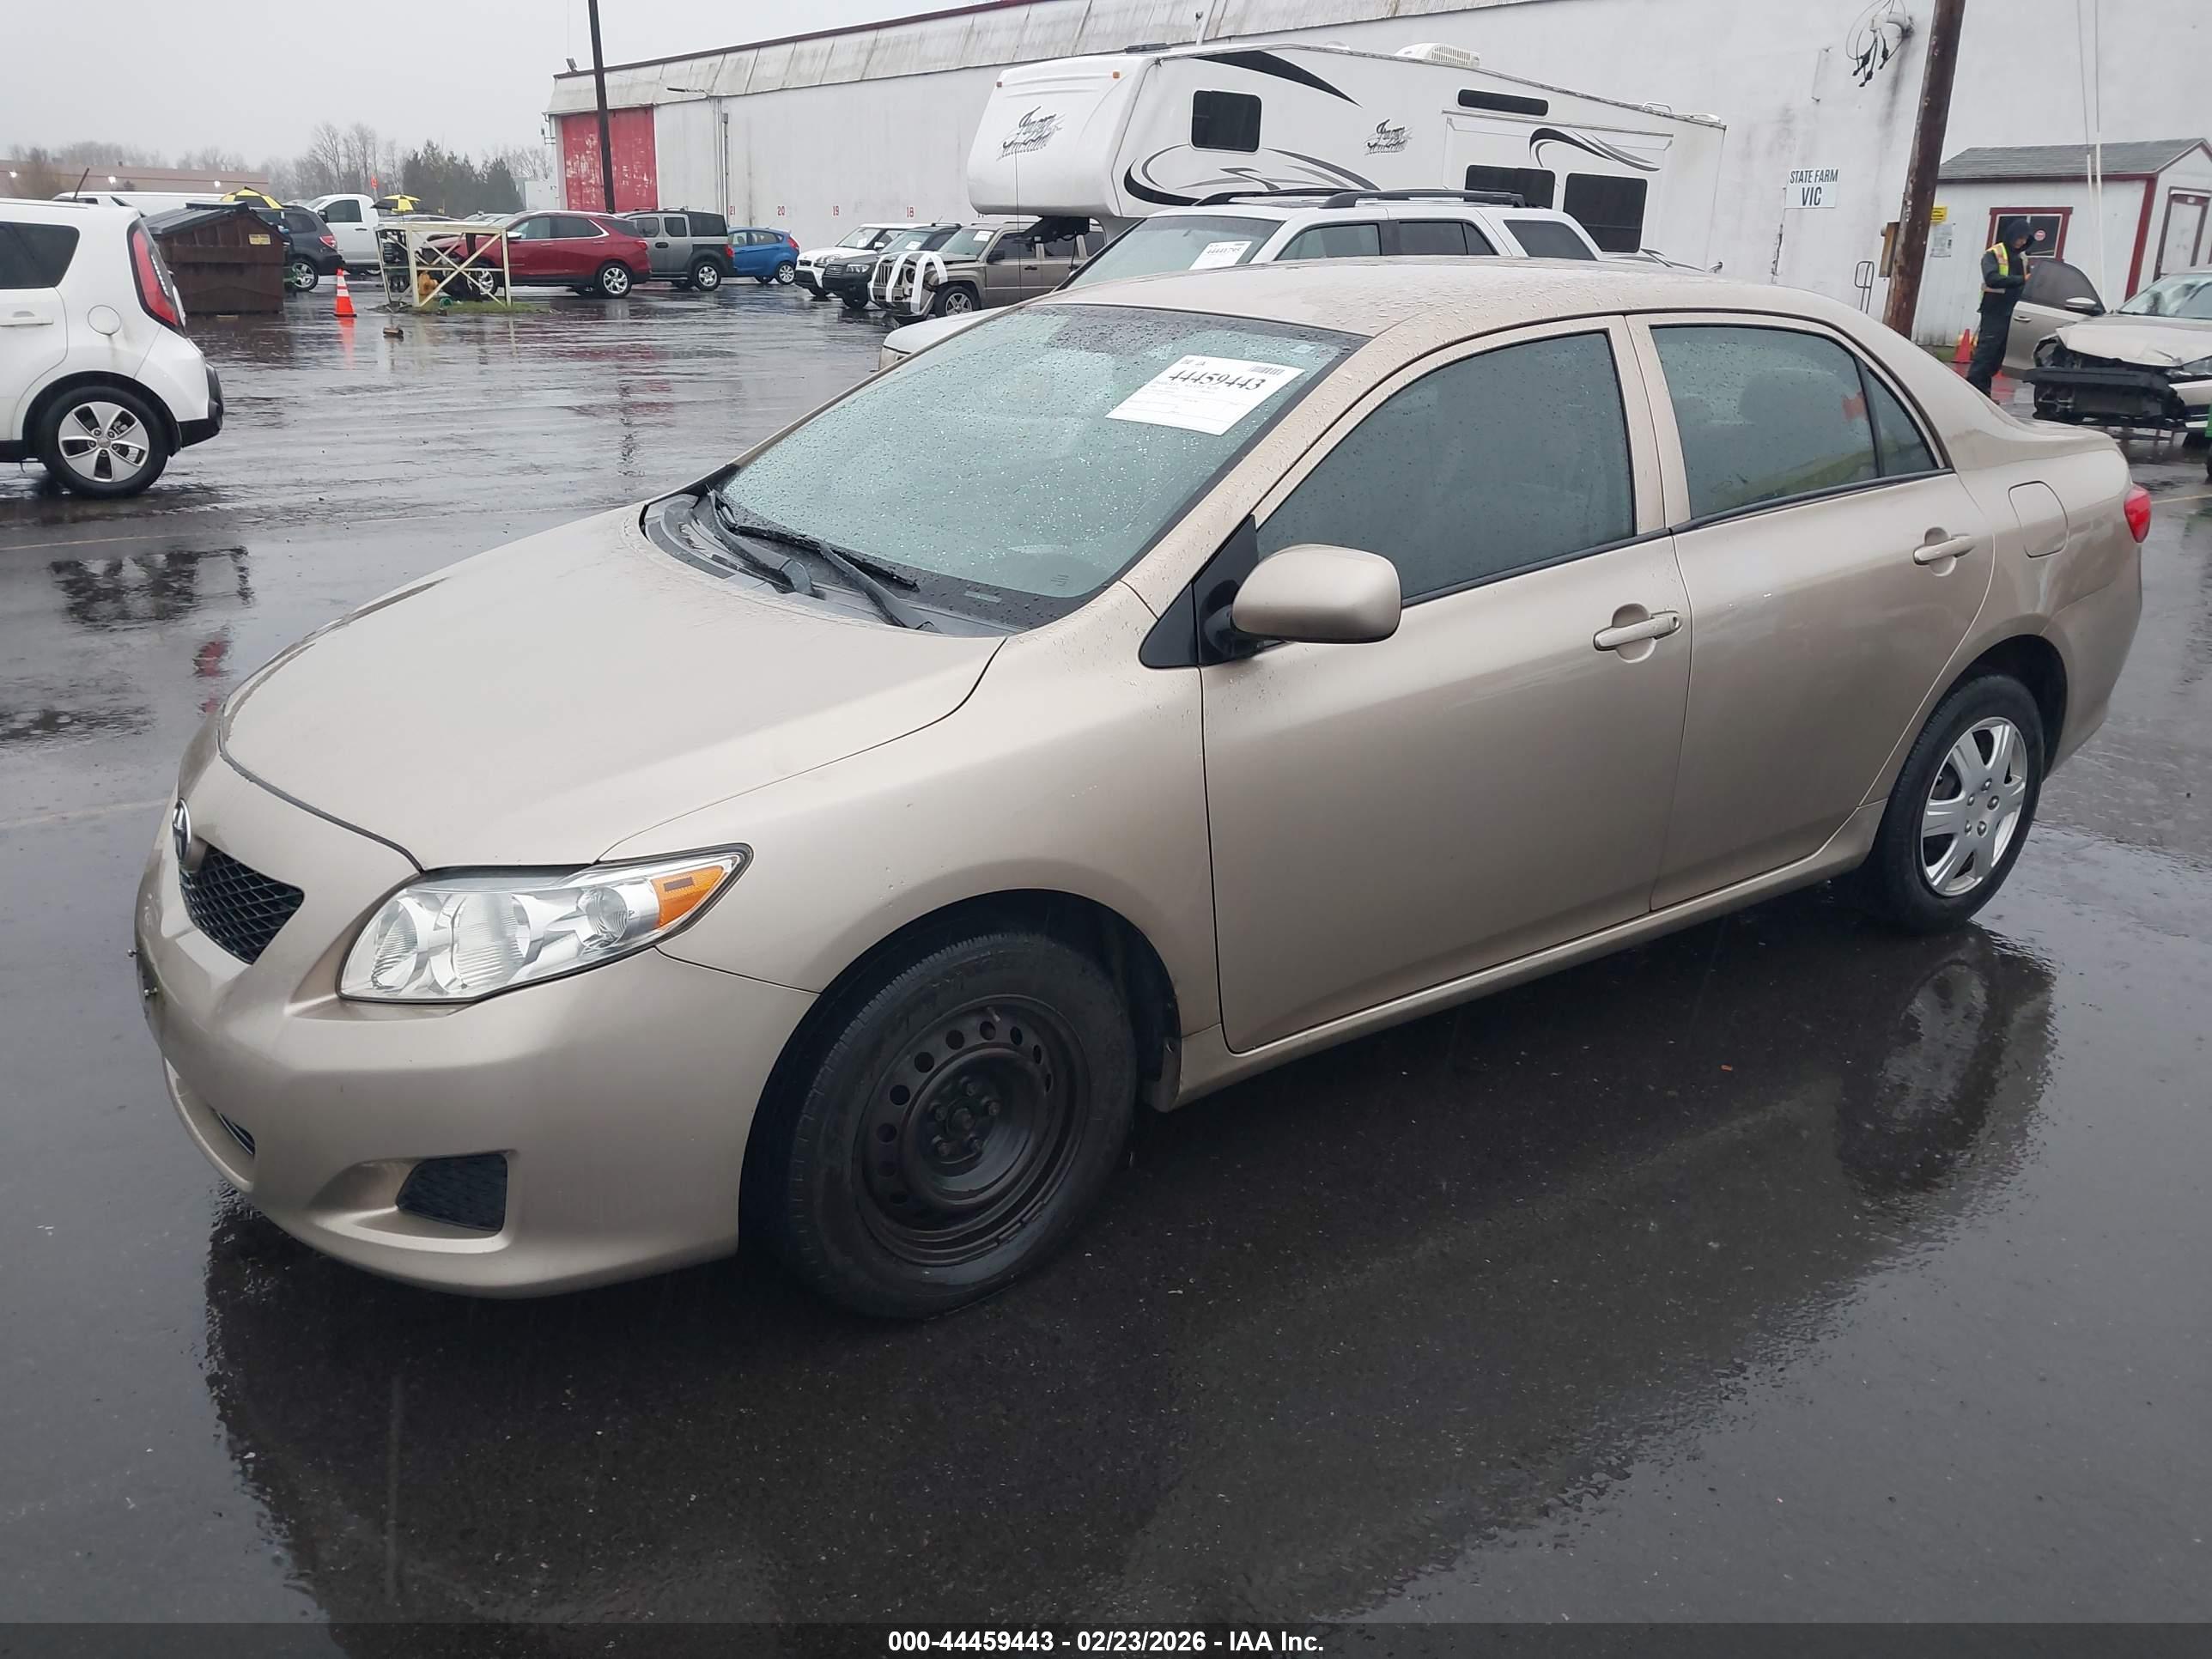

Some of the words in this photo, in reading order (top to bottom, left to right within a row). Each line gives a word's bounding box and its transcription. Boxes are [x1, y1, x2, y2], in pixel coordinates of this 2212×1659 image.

[1790, 170, 1814, 184] STATE
[1814, 168, 1838, 183] FARM
[1802, 186, 1822, 206] VIC
[729, 205, 736, 216] 21
[777, 205, 786, 216] 20
[833, 205, 840, 216] 19
[906, 206, 915, 218] 18
[1169, 369, 1267, 391] 44459443
